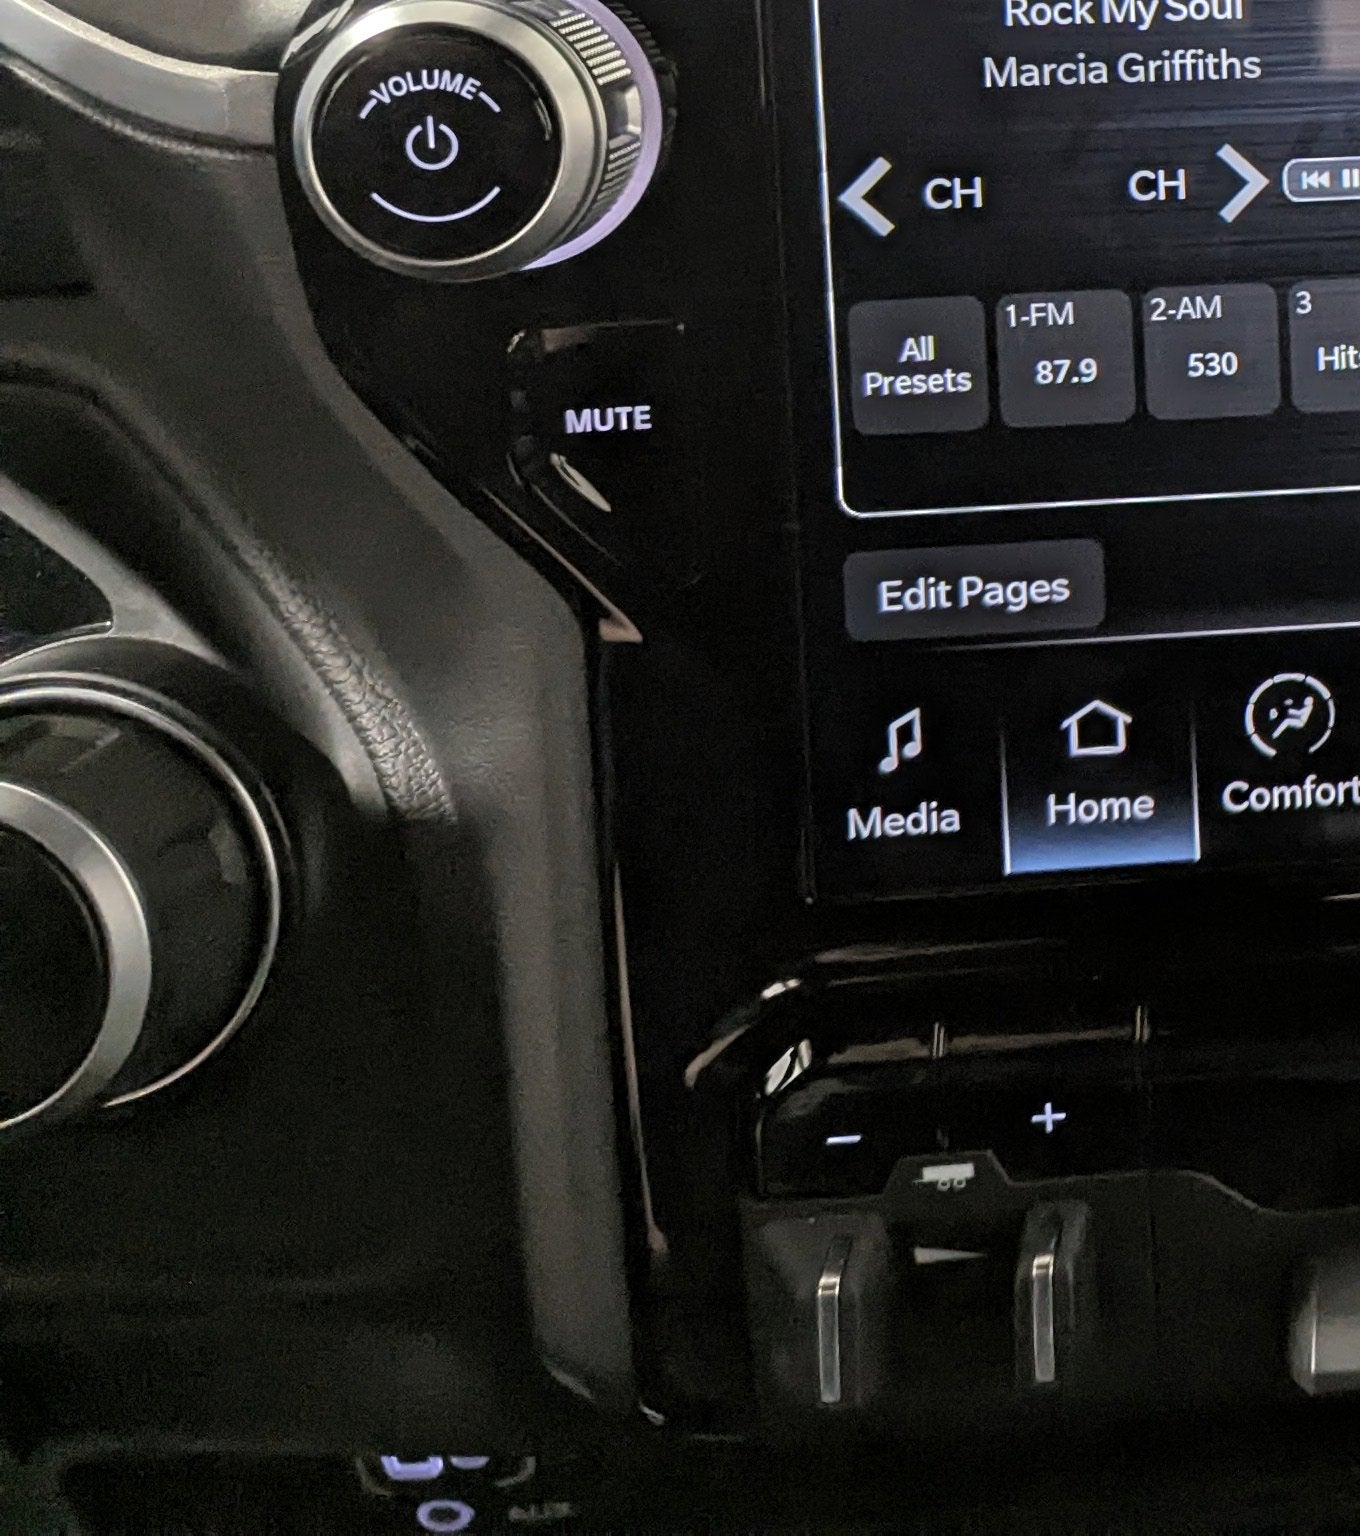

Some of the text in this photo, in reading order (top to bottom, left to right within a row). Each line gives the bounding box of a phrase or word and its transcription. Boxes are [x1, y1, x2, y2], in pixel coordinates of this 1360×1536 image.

[983, 47, 1262, 88] Marcia Griffiths
[369, 67, 482, 106] VOLUME
[924, 176, 983, 210] CH
[1128, 168, 1186, 201] CH
[1006, 301, 1074, 328] 1-FM
[1150, 294, 1222, 321] 2-AM
[1296, 290, 1312, 315] 3
[899, 335, 935, 363] All
[1036, 357, 1098, 385] 87.9
[1188, 351, 1238, 378] 530
[863, 368, 972, 396] Presets
[565, 405, 652, 434] MUTE
[879, 576, 1071, 612] Edit Pages
[847, 800, 961, 840] Media
[1047, 792, 1155, 826] Home
